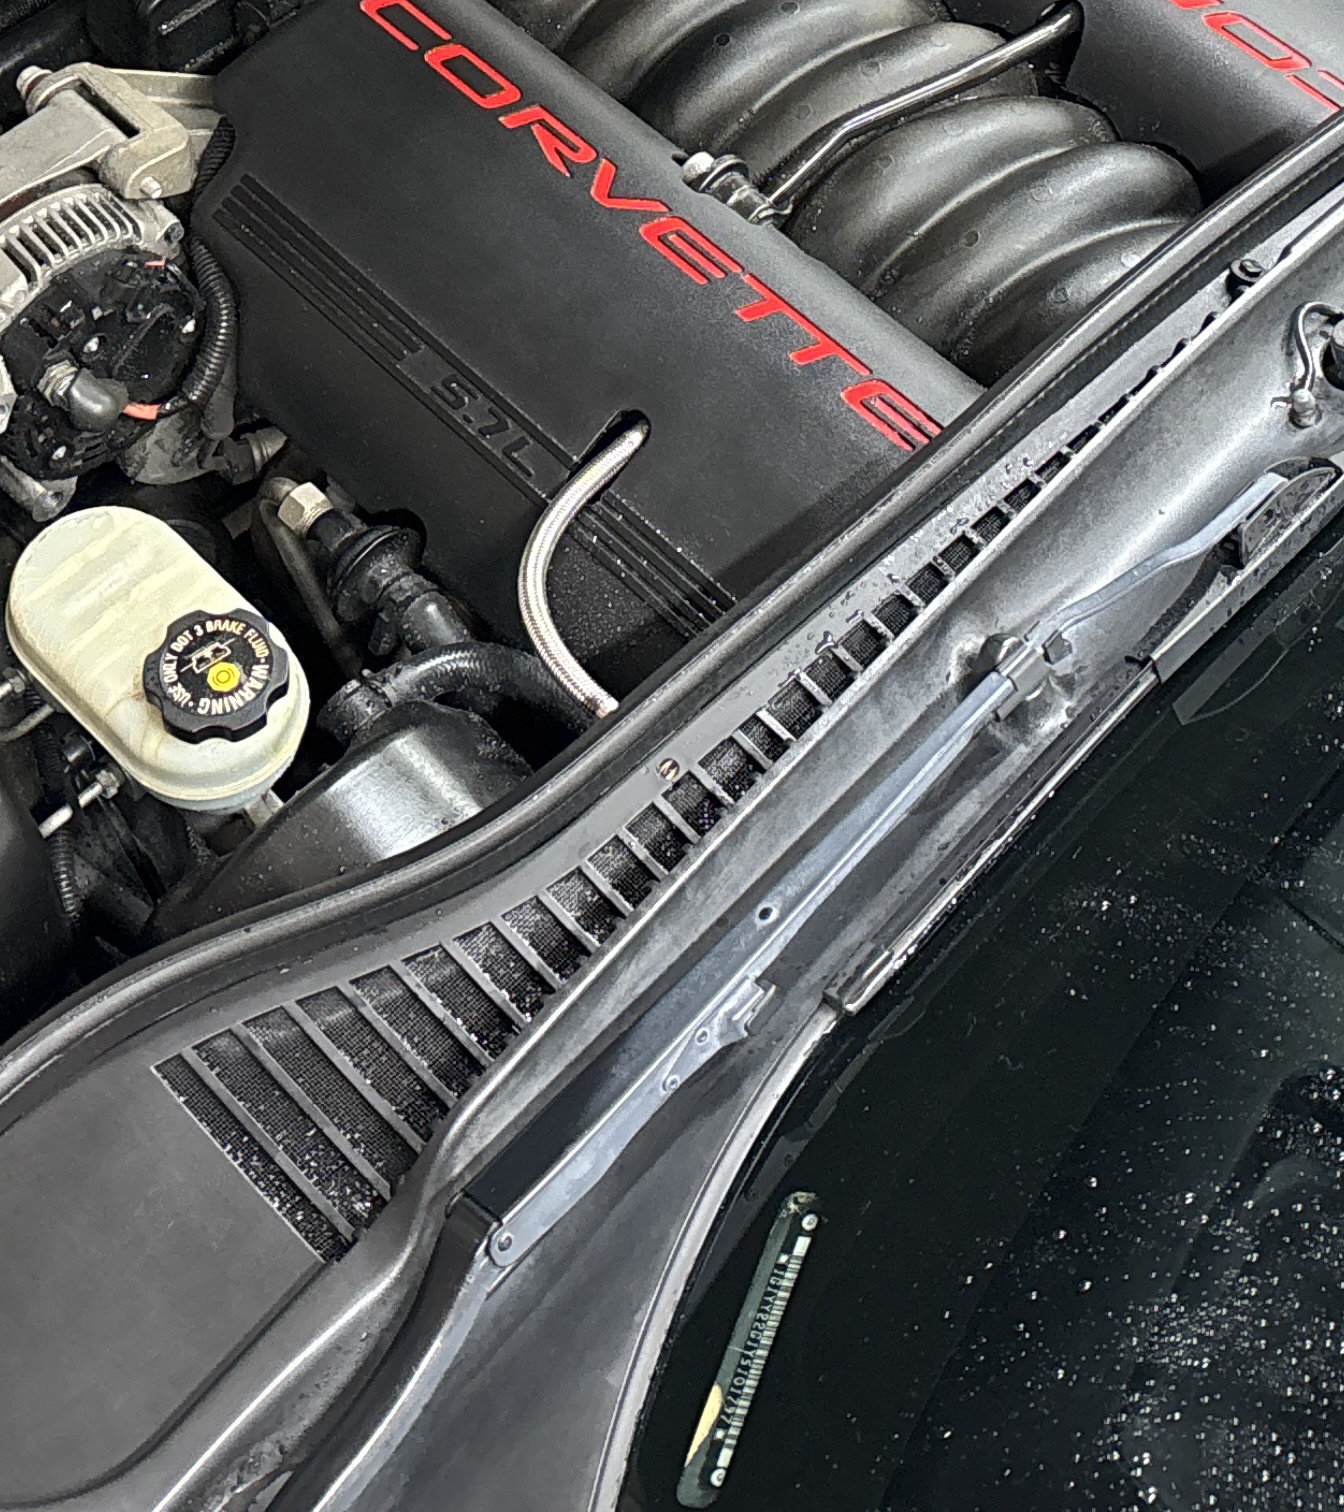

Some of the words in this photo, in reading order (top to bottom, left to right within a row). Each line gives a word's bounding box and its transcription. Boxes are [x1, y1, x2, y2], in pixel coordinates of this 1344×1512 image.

[430, 373, 536, 479] 5.7L
[194, 624, 204, 637] 3
[205, 619, 247, 636] BRAKE
[170, 630, 195, 653] DOT
[244, 629, 269, 658] FLUID
[163, 653, 179, 684] ONLY
[167, 685, 192, 709] USE
[197, 664, 270, 715] WARNING
